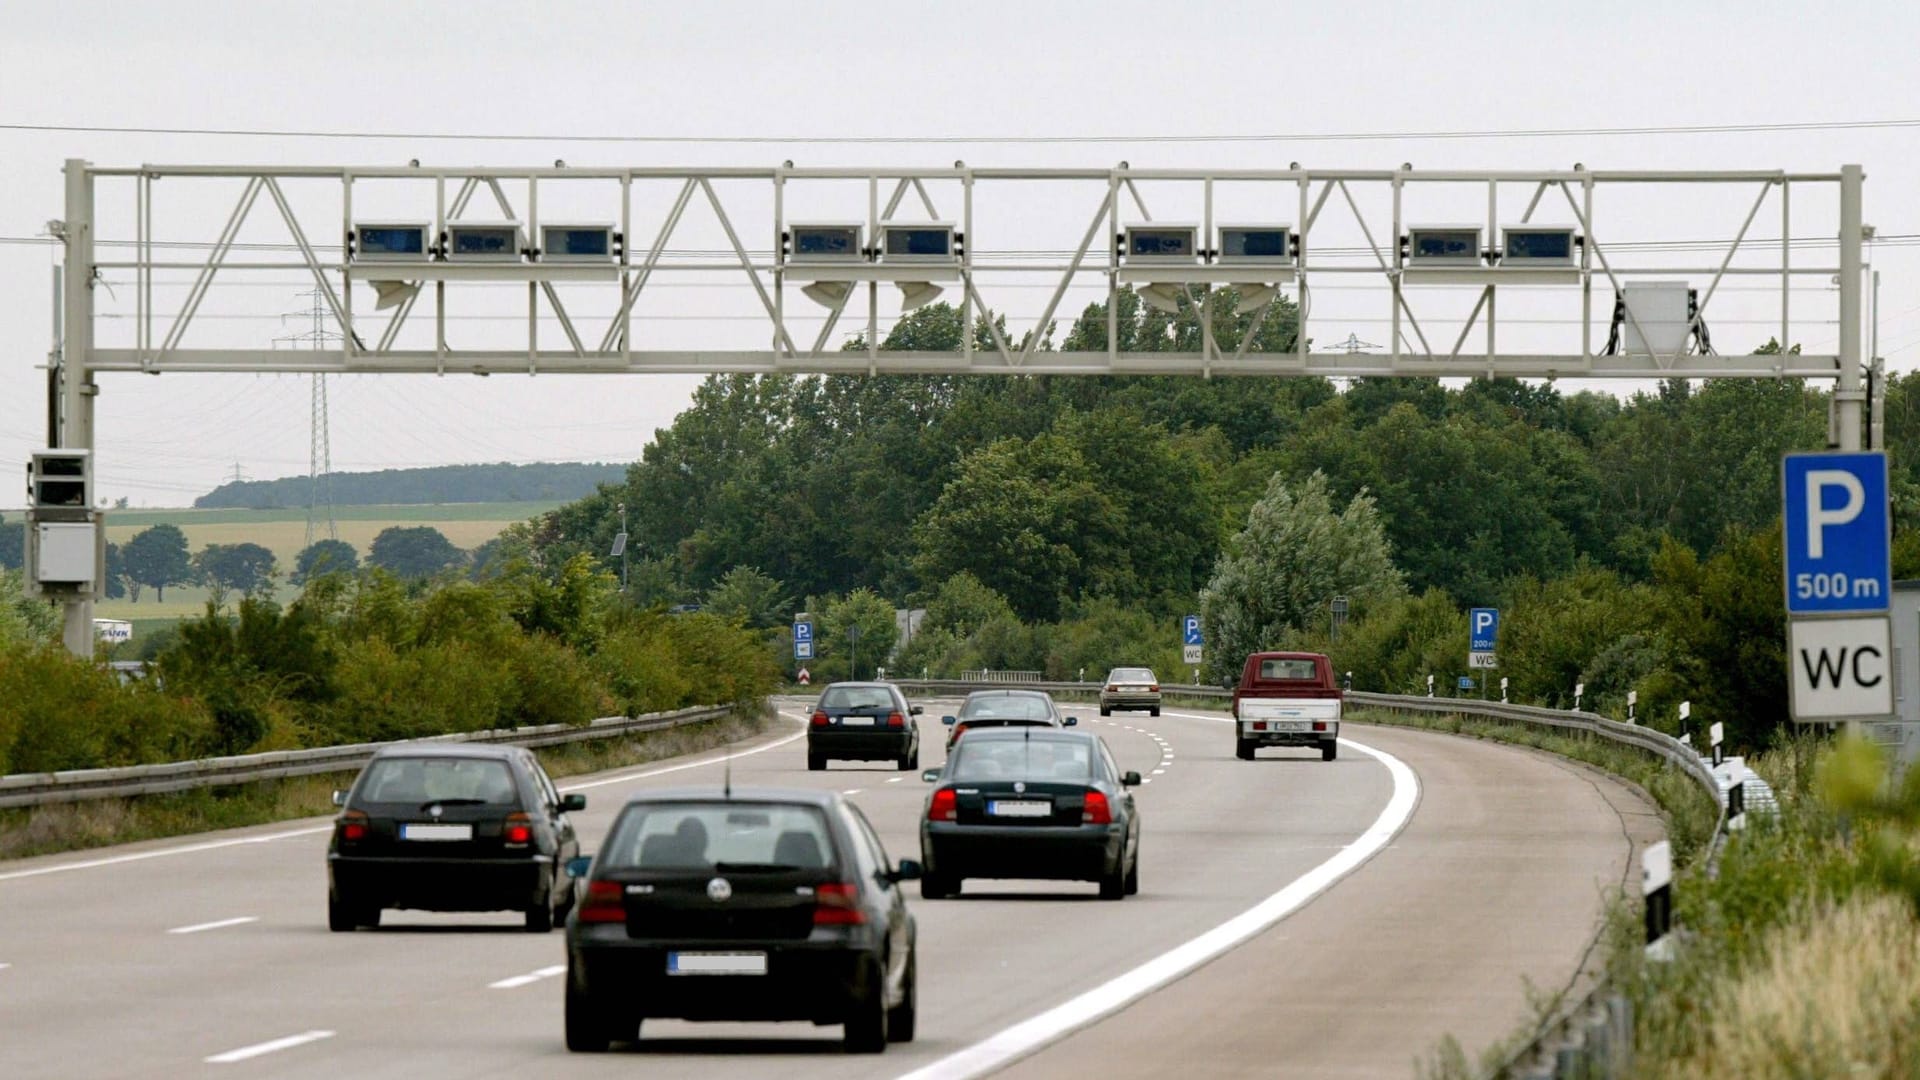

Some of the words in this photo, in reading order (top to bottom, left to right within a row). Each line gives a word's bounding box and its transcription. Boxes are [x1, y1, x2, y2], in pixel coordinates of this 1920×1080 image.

[1805, 469, 1866, 559] P
[1796, 572, 1848, 599] 500
[1853, 577, 1880, 598] m
[797, 624, 808, 639] P
[1187, 619, 1198, 636] P
[1477, 612, 1493, 635] P
[1186, 650, 1200, 659] WC
[1801, 645, 1882, 690] WC
